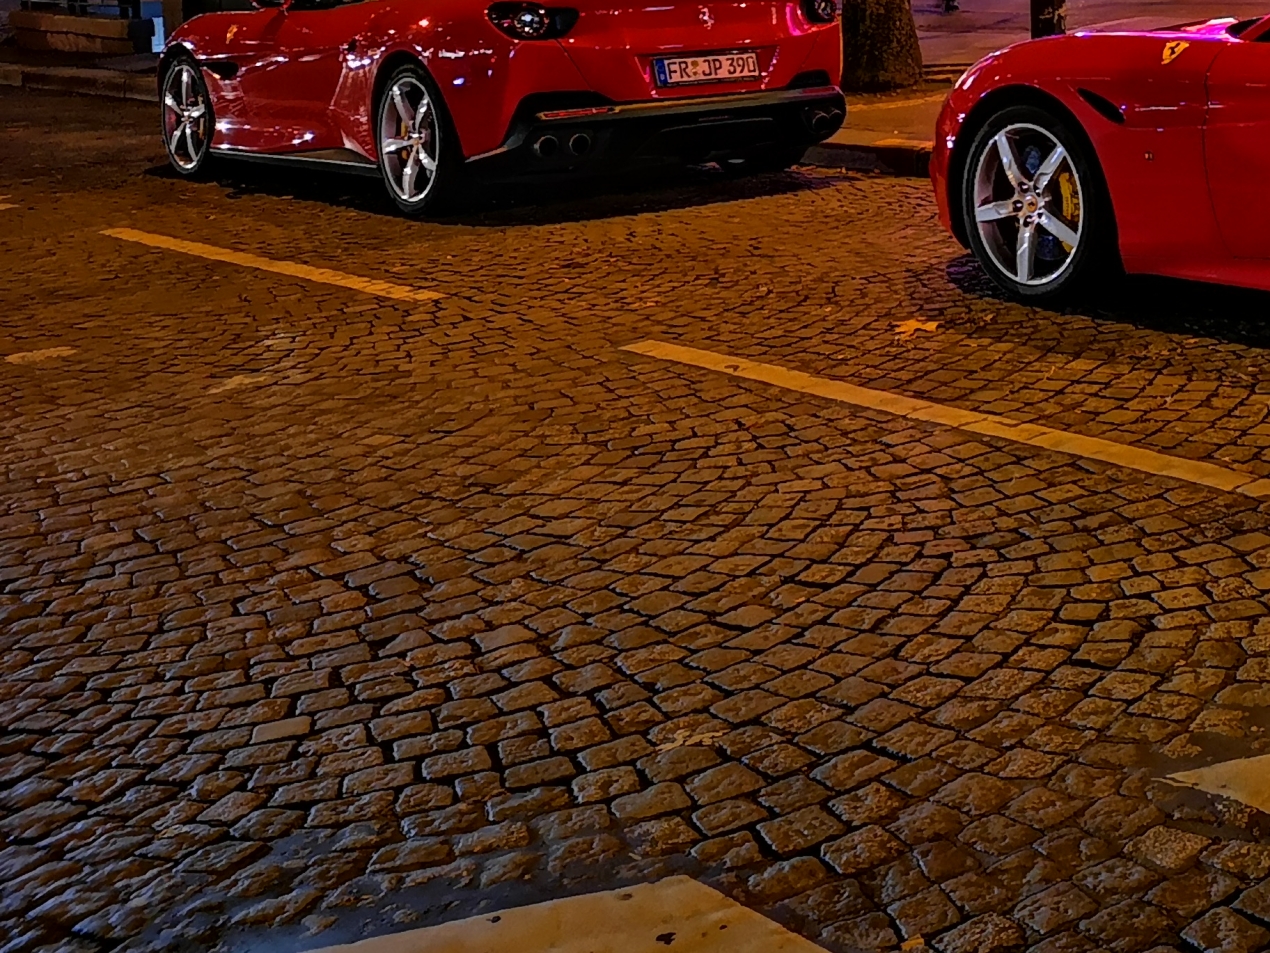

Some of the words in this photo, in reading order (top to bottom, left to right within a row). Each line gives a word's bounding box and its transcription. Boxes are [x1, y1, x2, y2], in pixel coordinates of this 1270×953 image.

[666, 60, 691, 80] FR
[702, 57, 723, 77] JP
[725, 55, 757, 75] 390
